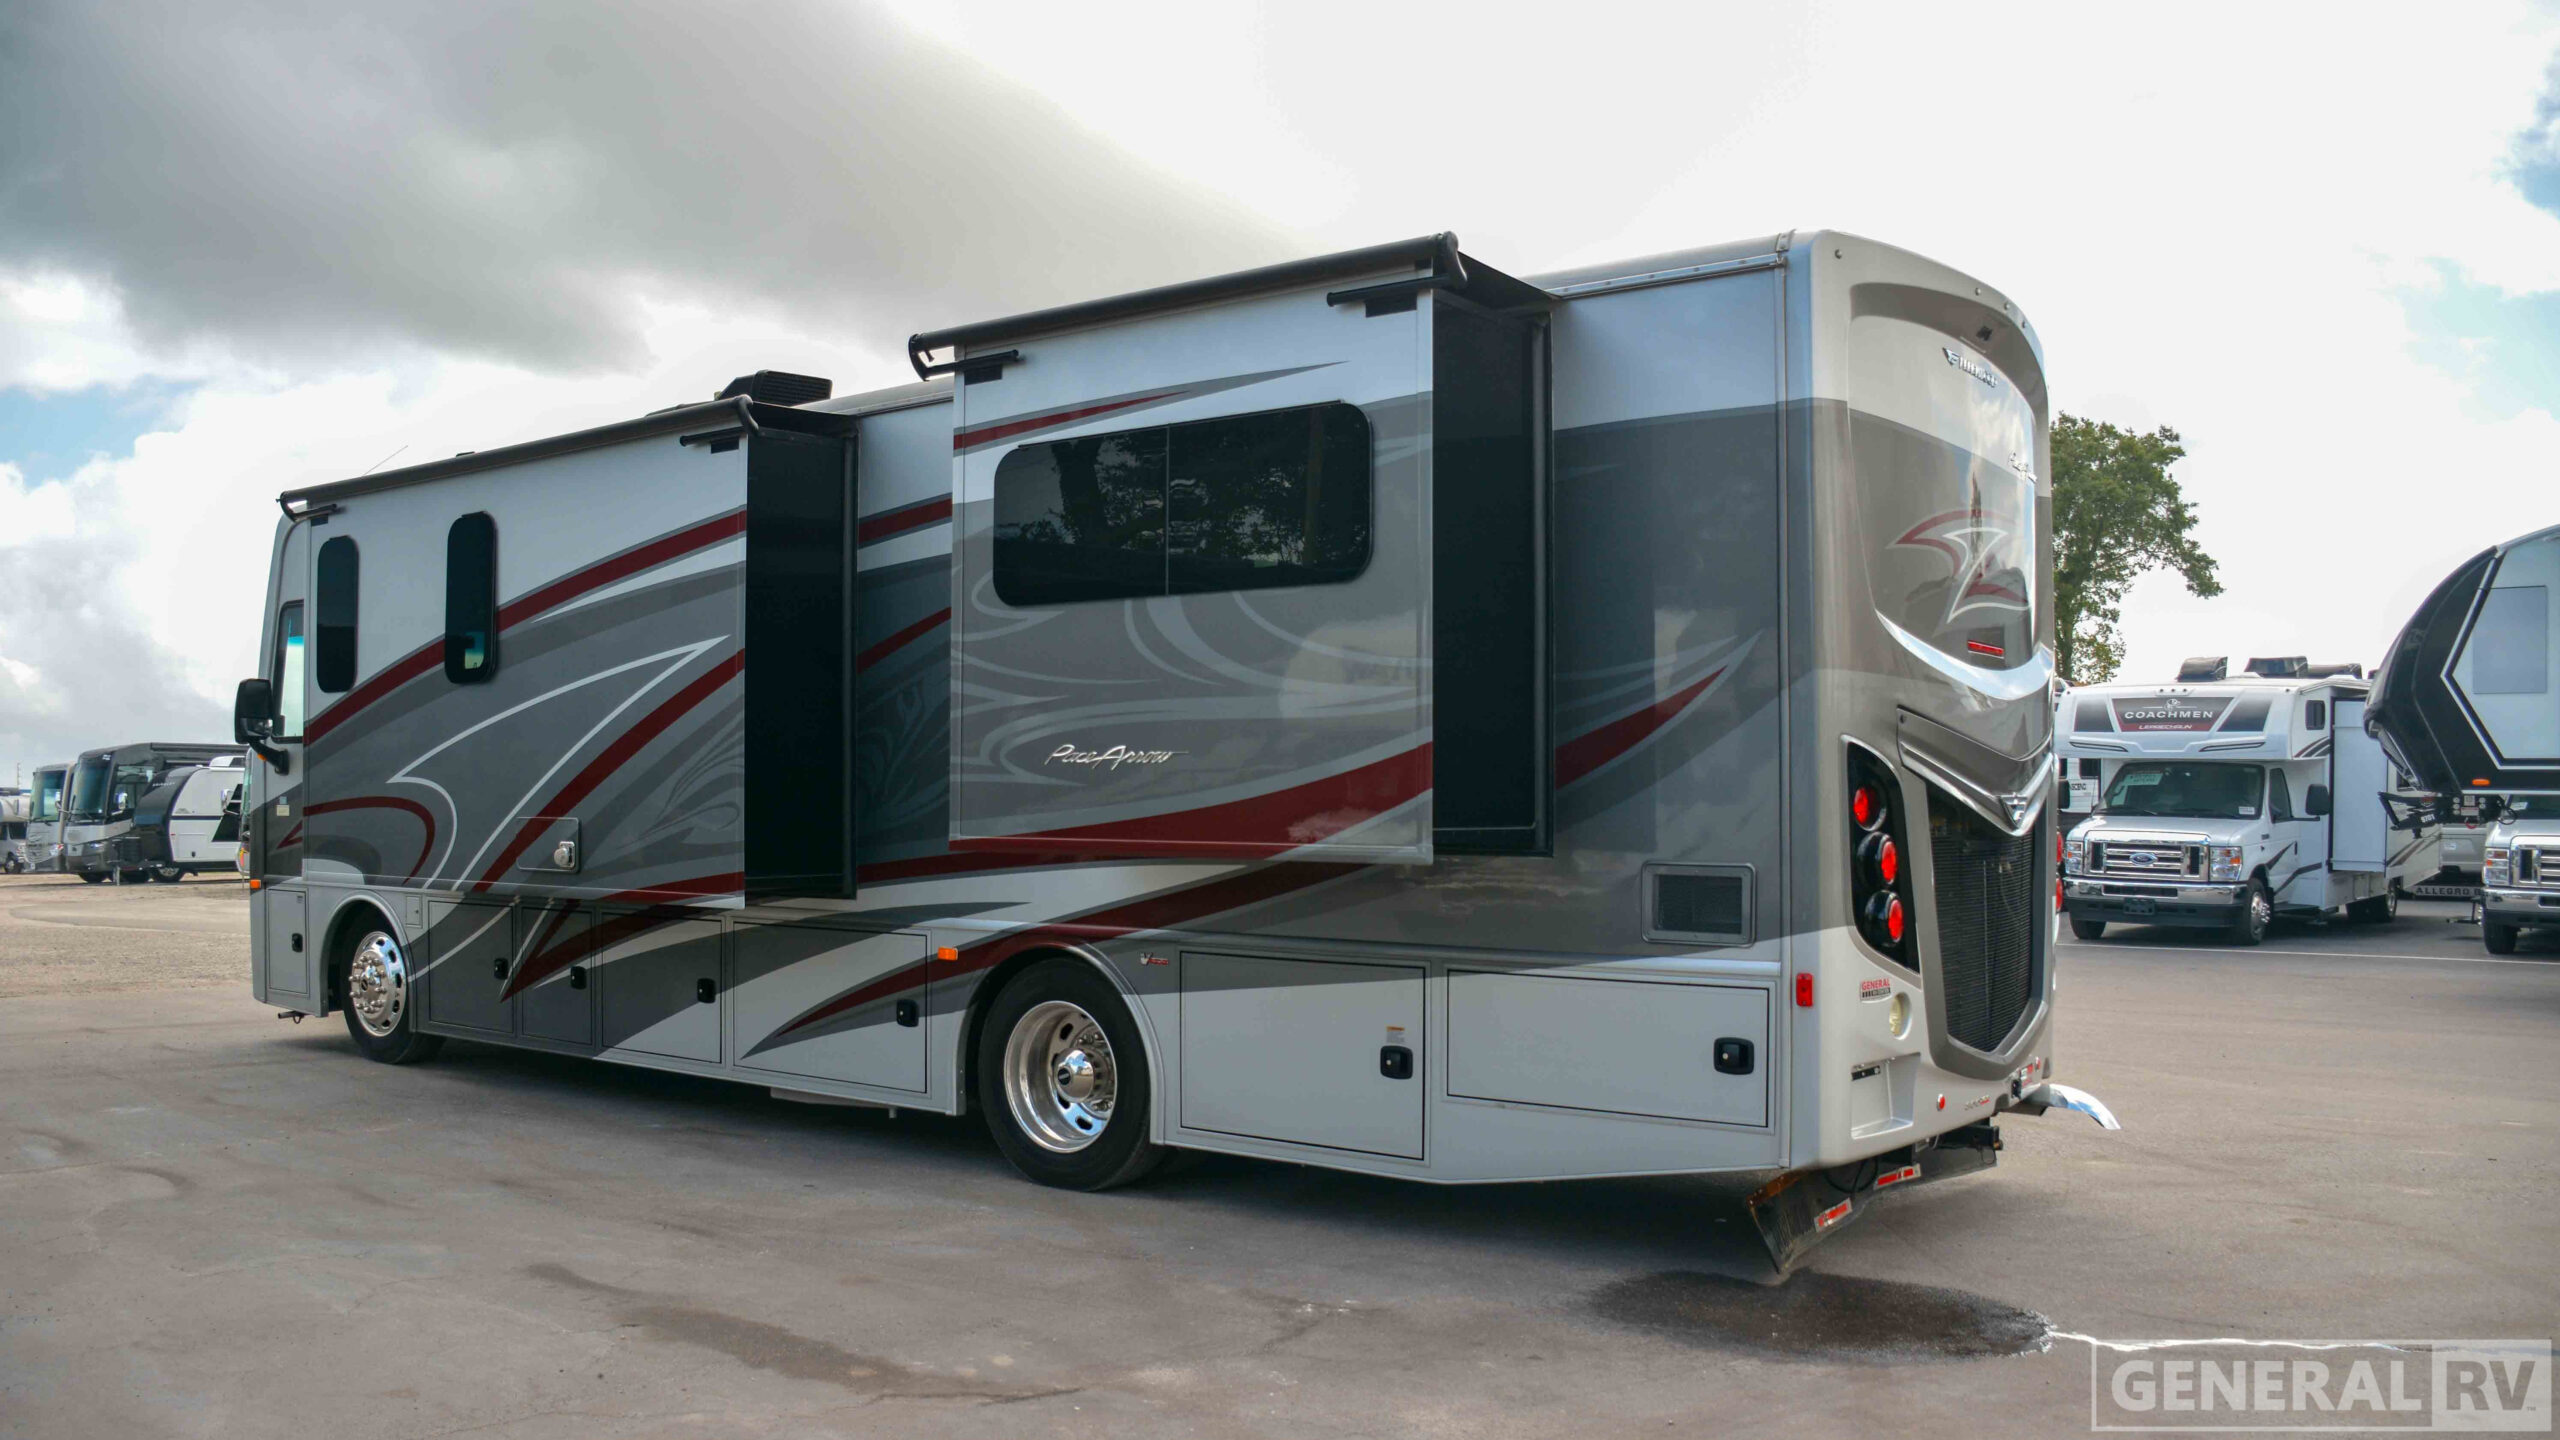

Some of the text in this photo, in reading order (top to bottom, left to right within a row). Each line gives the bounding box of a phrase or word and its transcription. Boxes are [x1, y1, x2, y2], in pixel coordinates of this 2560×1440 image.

[2124, 710, 2213, 719] COACHMEN
[2416, 887, 2470, 895] ALLEGRO
[1861, 978, 1890, 990] GENERAL
